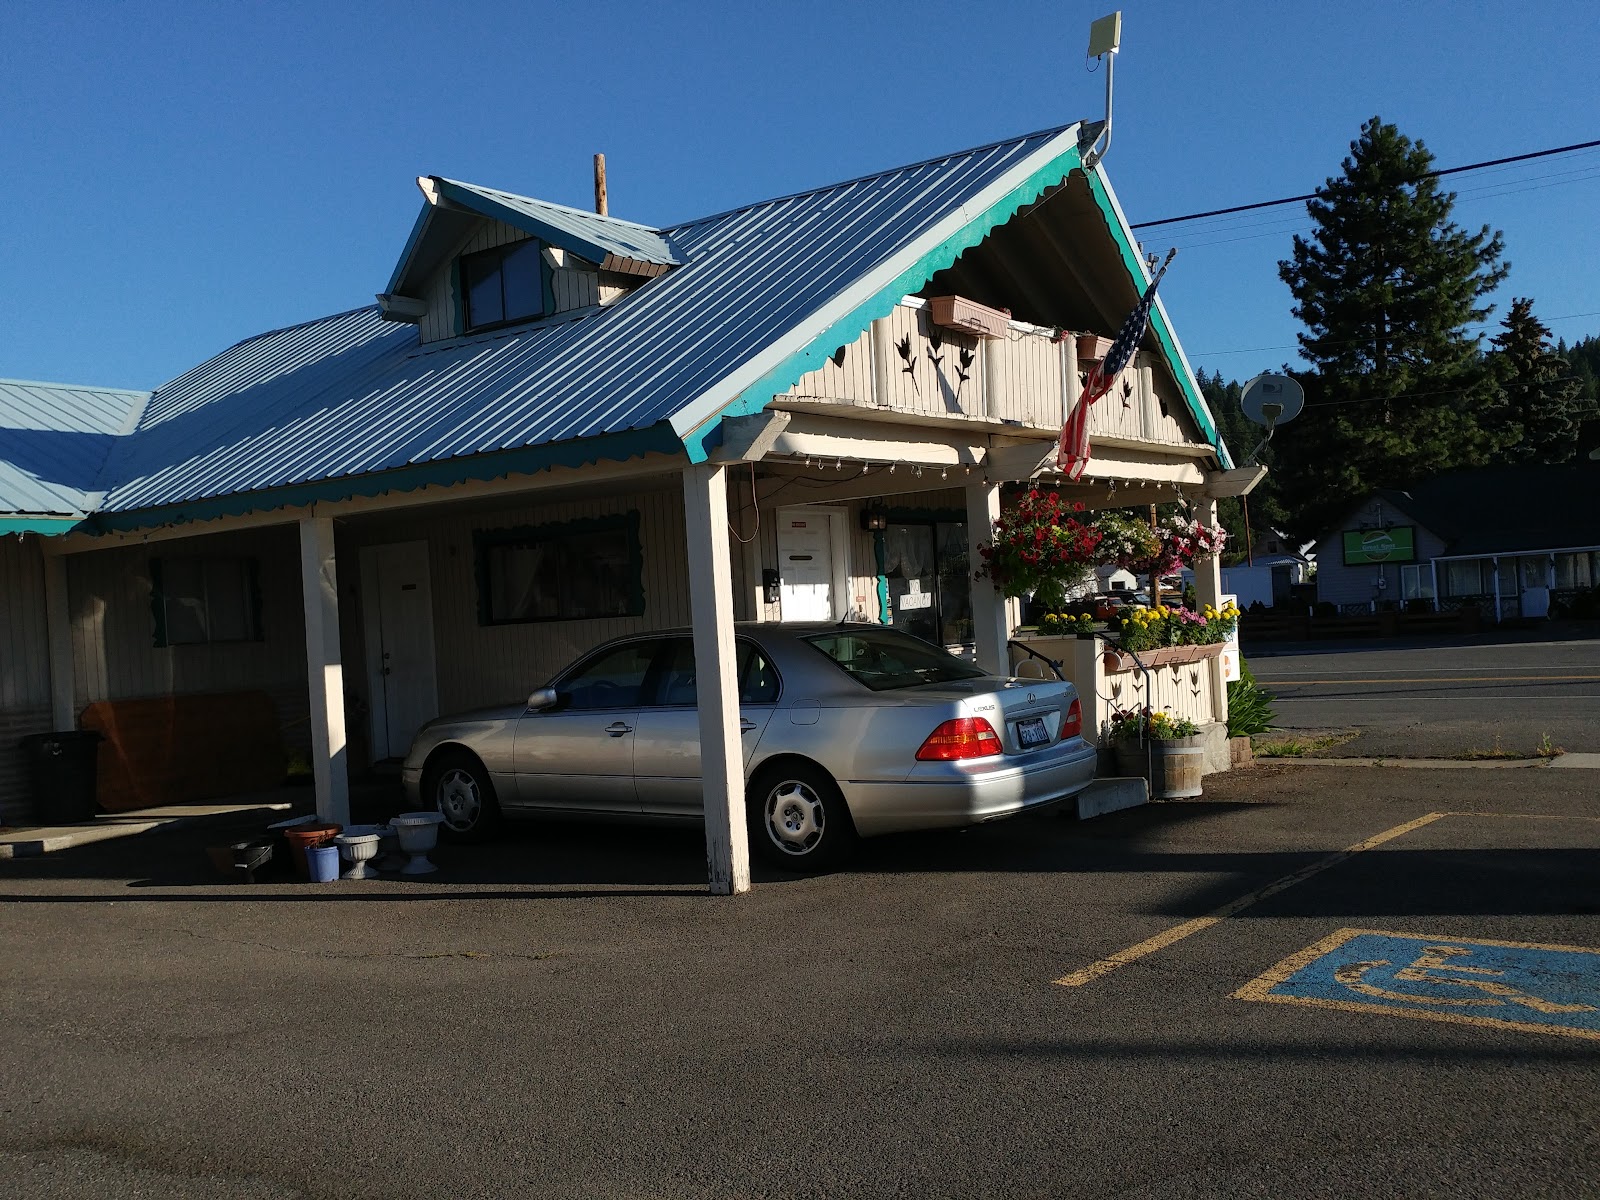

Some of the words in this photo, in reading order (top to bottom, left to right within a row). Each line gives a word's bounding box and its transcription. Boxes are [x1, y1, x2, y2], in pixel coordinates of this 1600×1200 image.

[910, 581, 919, 593] NO
[901, 595, 930, 608] VACANCY
[973, 704, 996, 713] LEXUS
